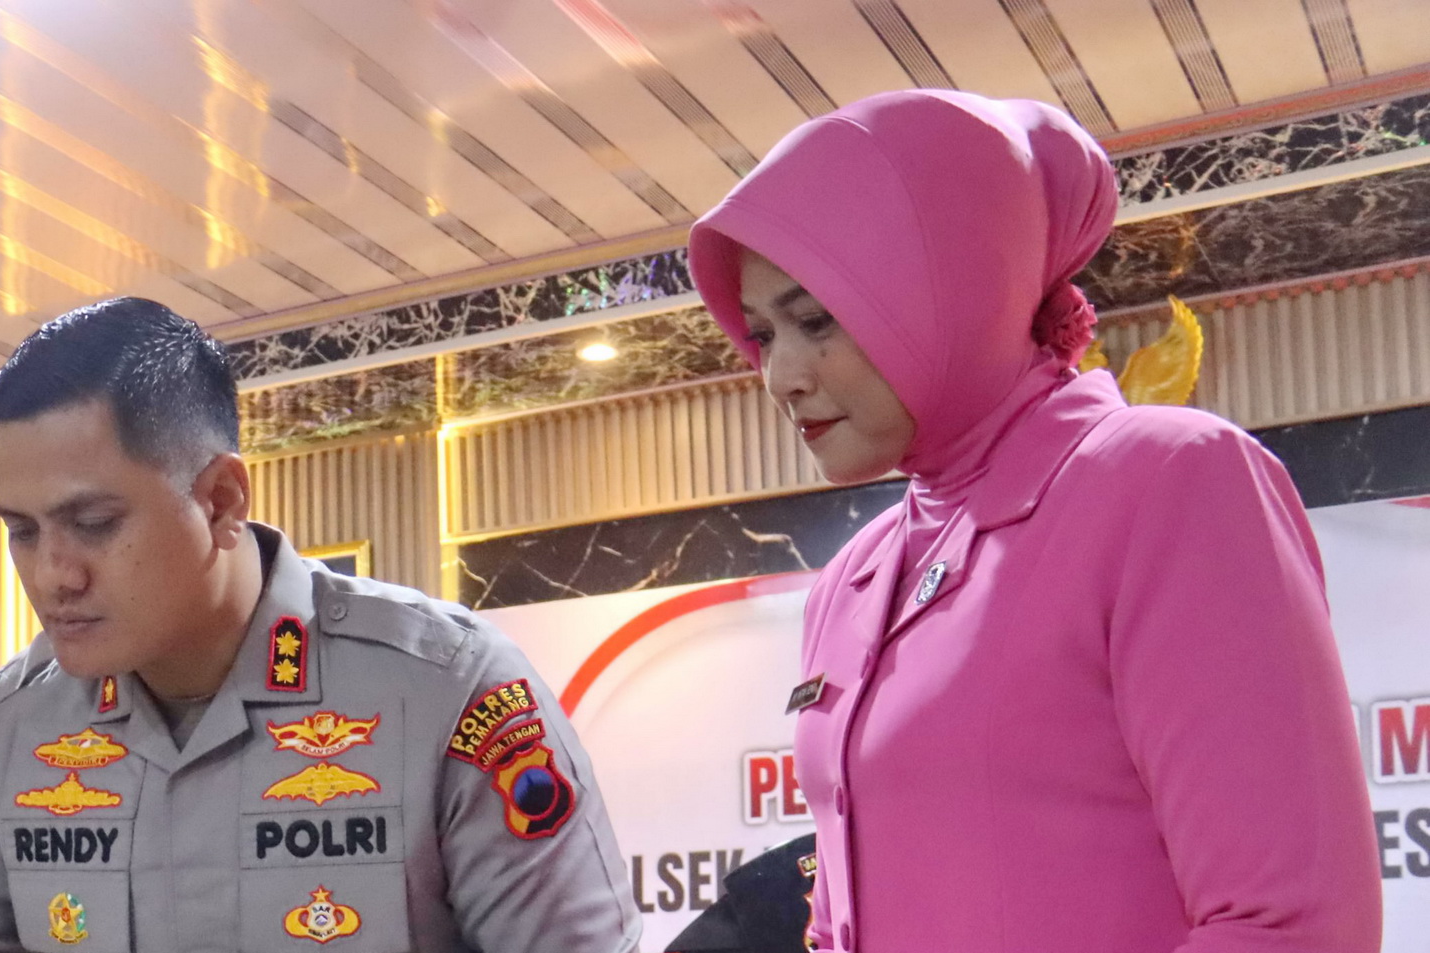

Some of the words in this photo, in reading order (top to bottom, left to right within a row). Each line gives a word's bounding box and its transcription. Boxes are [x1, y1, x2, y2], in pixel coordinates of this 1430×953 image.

[451, 683, 526, 752] POLRES
[465, 697, 529, 756] PEMALANG
[481, 743, 505, 765] JAWA
[506, 724, 540, 745] TENGAH
[749, 755, 807, 818] PE
[1379, 704, 1430, 776] M
[13, 827, 119, 863] RENDY
[256, 816, 387, 859] POLRI
[632, 849, 744, 913] LSEK
[1373, 807, 1430, 879] ES
